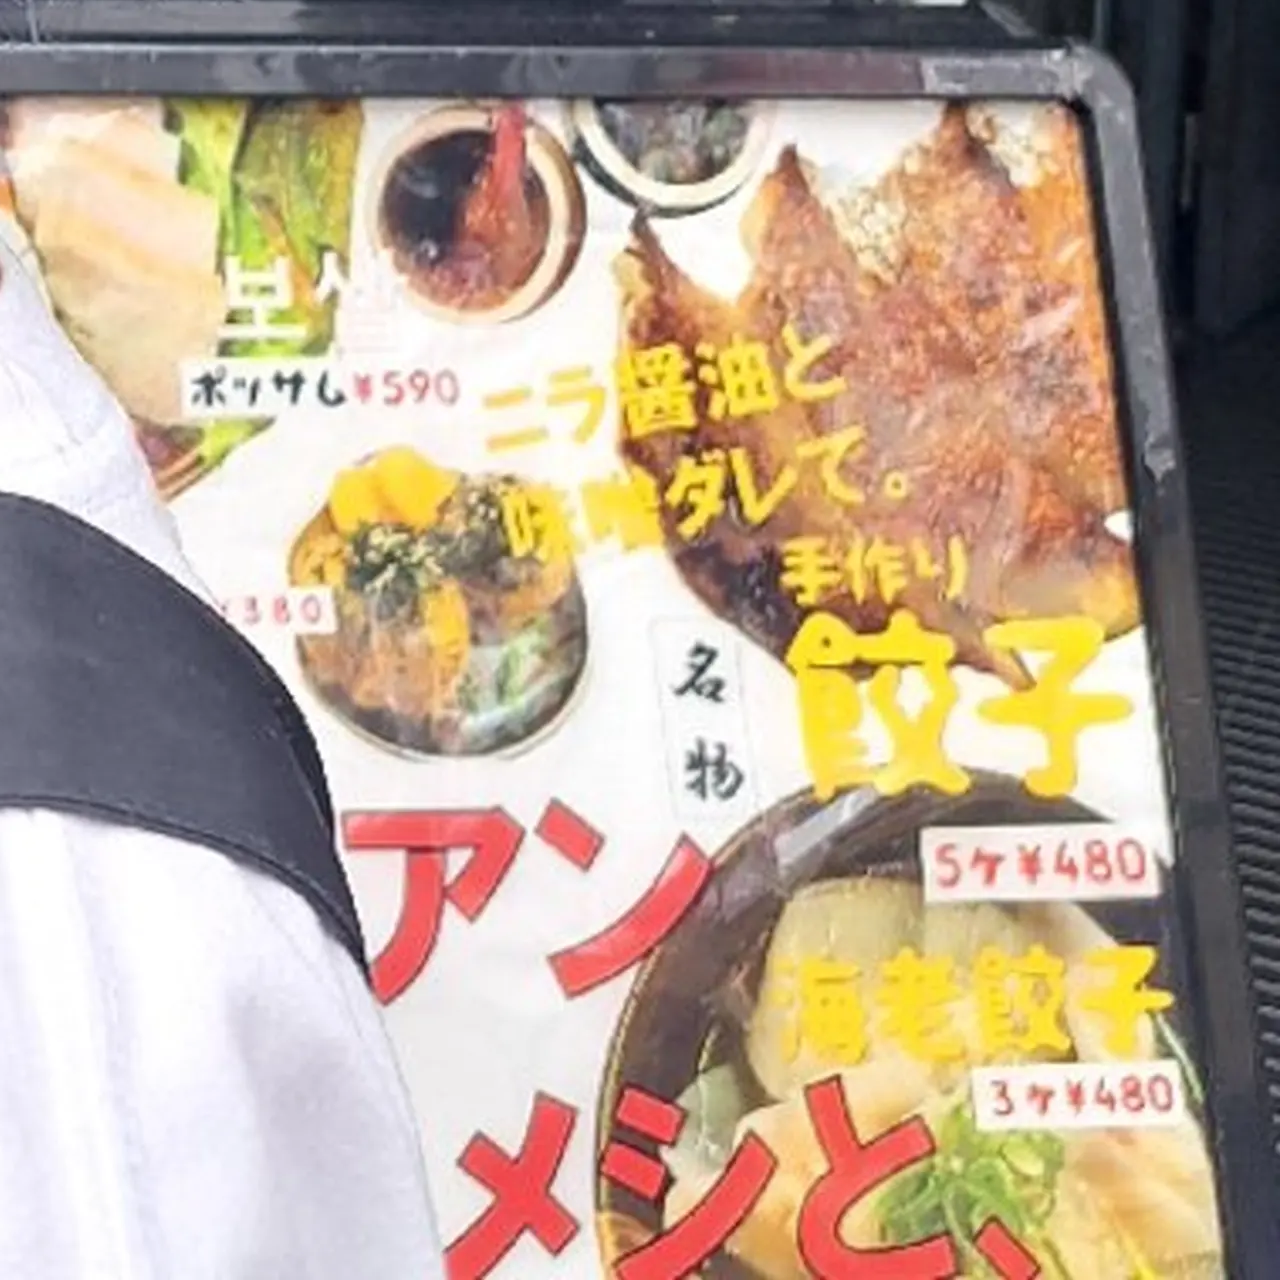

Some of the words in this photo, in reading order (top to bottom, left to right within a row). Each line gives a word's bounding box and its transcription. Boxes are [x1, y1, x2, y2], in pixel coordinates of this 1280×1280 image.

[482, 324, 848, 454] ニラ醤油と
[780, 534, 968, 607] 手作り
[674, 640, 744, 801] 名物
[787, 610, 1135, 803] 餃子
[772, 944, 1176, 1068] 海老餃子
